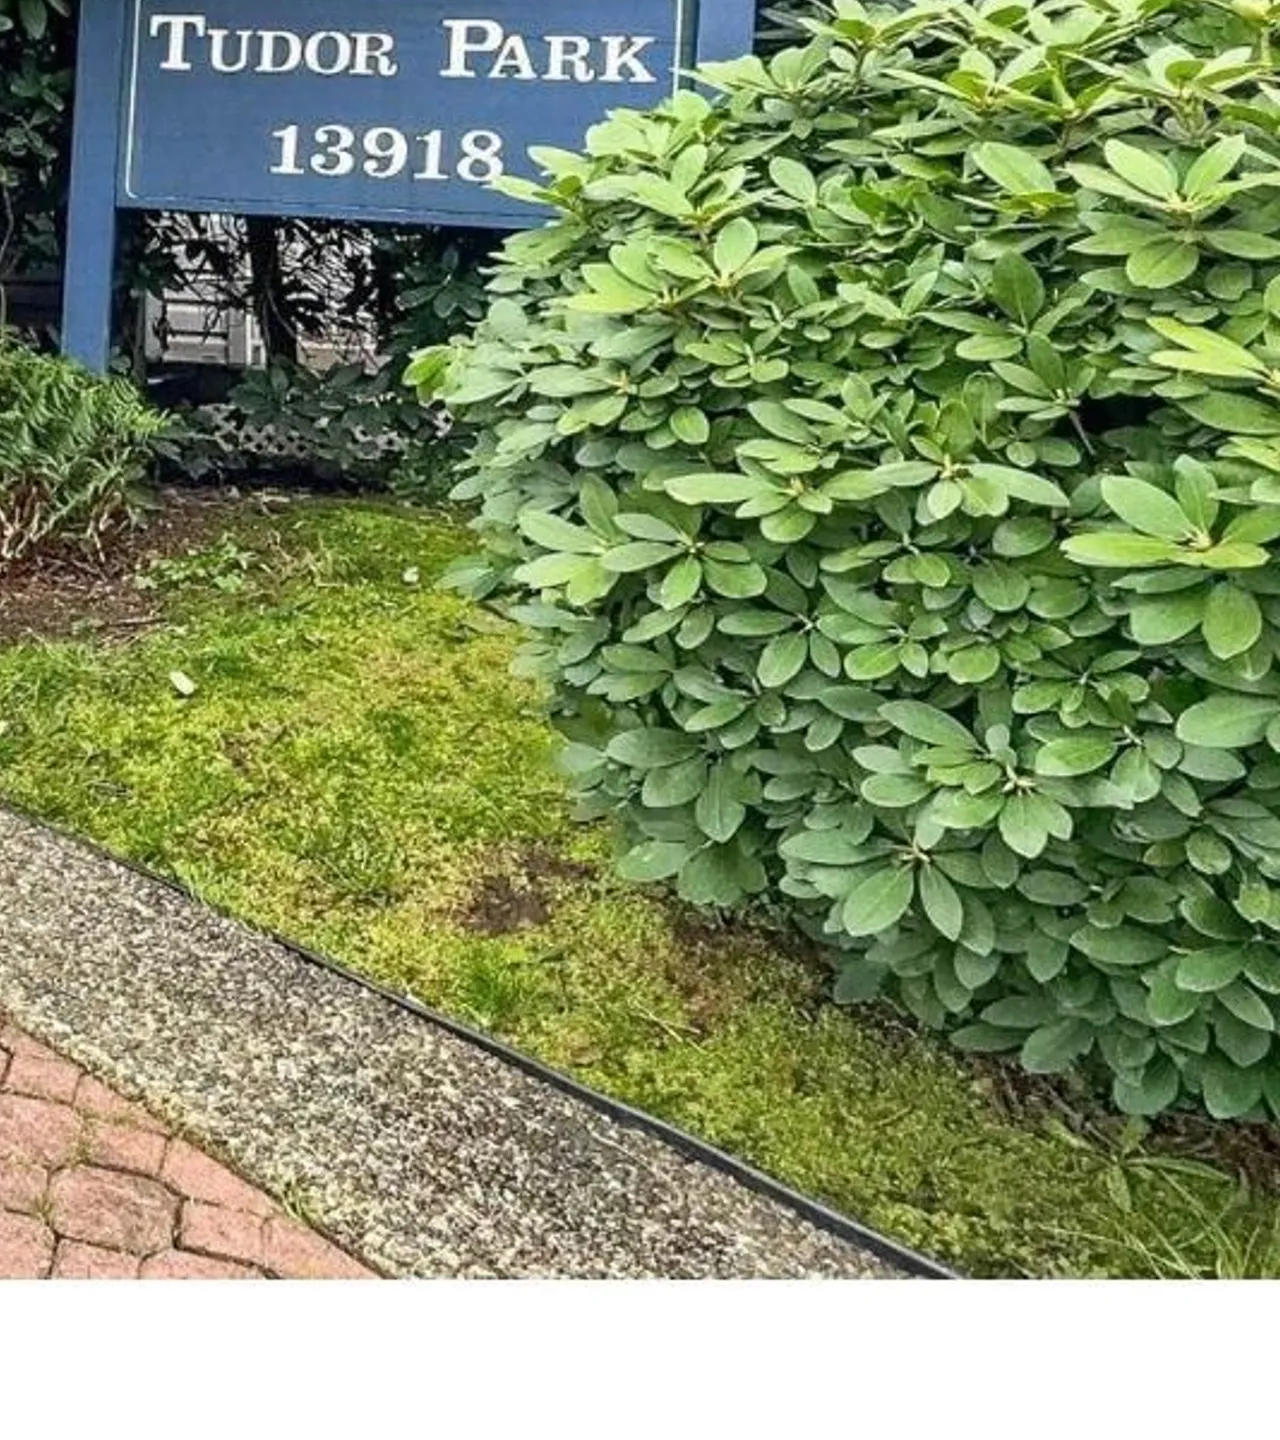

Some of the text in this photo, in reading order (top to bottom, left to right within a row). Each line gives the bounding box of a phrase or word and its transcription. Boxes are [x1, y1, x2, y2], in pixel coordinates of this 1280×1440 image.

[149, 13, 657, 84] TUDOR PARK
[268, 123, 505, 184] 13918
